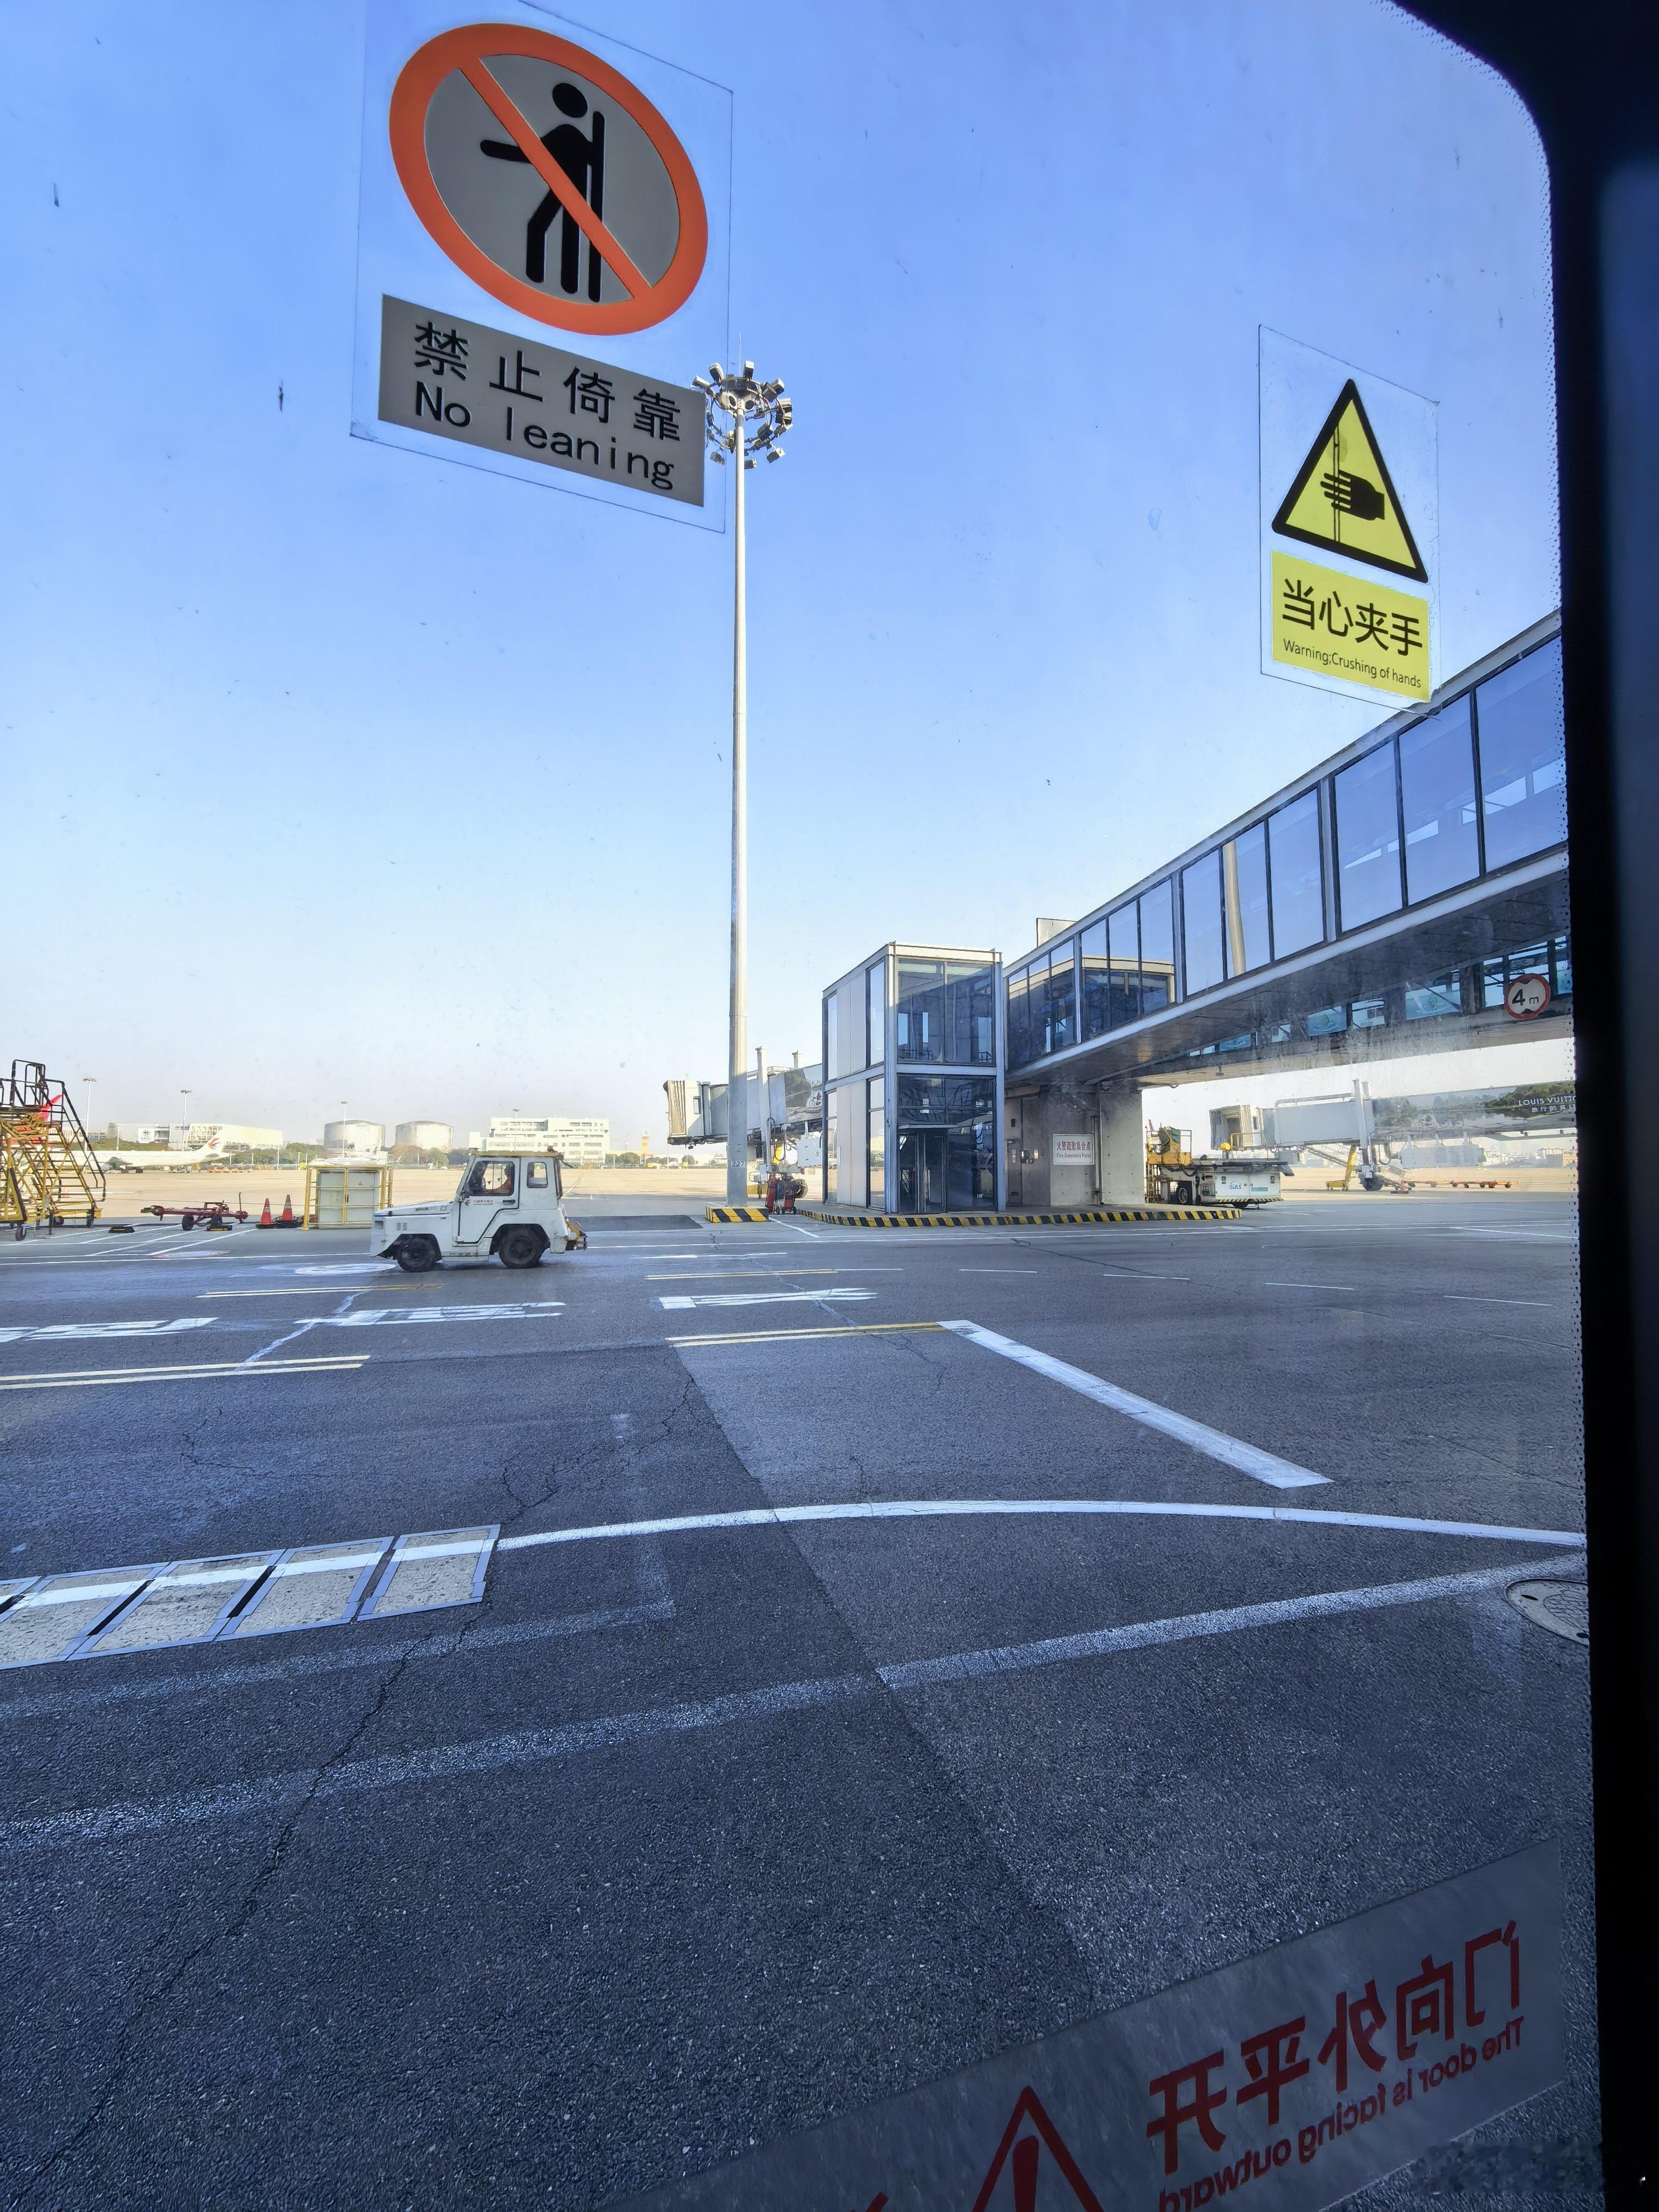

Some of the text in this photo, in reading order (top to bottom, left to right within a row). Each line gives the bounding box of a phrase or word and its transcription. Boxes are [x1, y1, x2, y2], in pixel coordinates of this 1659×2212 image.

[414, 322, 680, 442] 禁止倚靠
[415, 381, 675, 490] No leaning
[1282, 578, 1423, 656] 当心夹手
[1379, 667, 1390, 679] of
[1392, 670, 1421, 689] hands
[1512, 988, 1539, 1006] 4 m
[1518, 1098, 1545, 1106] LOUIS
